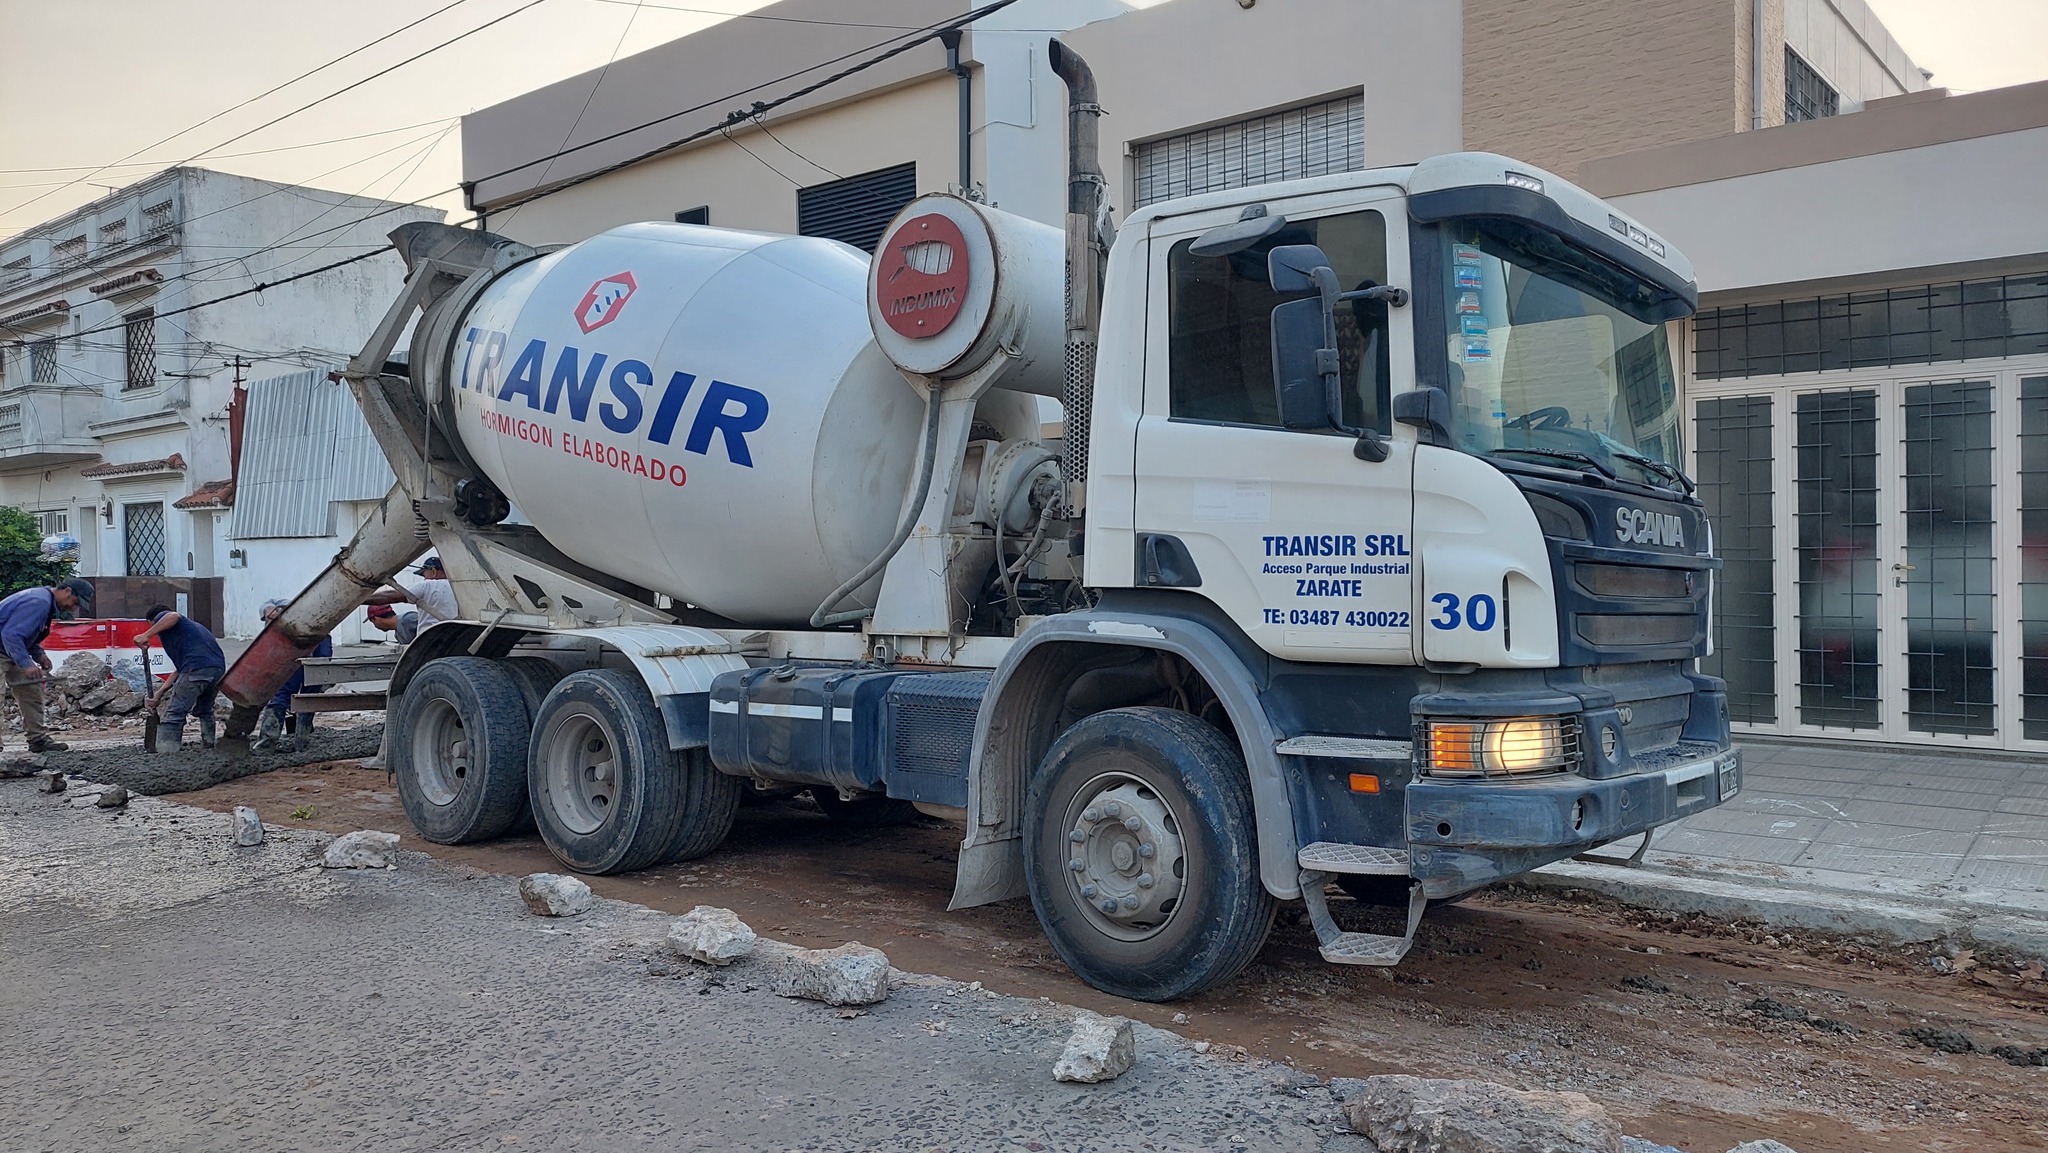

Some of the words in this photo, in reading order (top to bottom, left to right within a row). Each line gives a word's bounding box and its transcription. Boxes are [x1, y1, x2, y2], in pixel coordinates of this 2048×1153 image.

[889, 286, 957, 317] INDUMIX
[460, 327, 770, 469] TRANSIR
[480, 407, 553, 448] HORMIGON
[563, 432, 688, 488] ELABORADO
[1616, 506, 1685, 548] SCANIA
[1262, 535, 1356, 556] TRANSIR
[1364, 534, 1410, 556] SRL
[1262, 562, 1303, 574] Acceso
[1306, 562, 1347, 577] Parque
[1350, 562, 1410, 575] Industrial
[1296, 579, 1362, 597] ZARATE
[1263, 608, 1285, 624] TE:
[1289, 609, 1340, 626] 03487
[1345, 610, 1410, 628] 430022
[1430, 592, 1497, 632] 30
